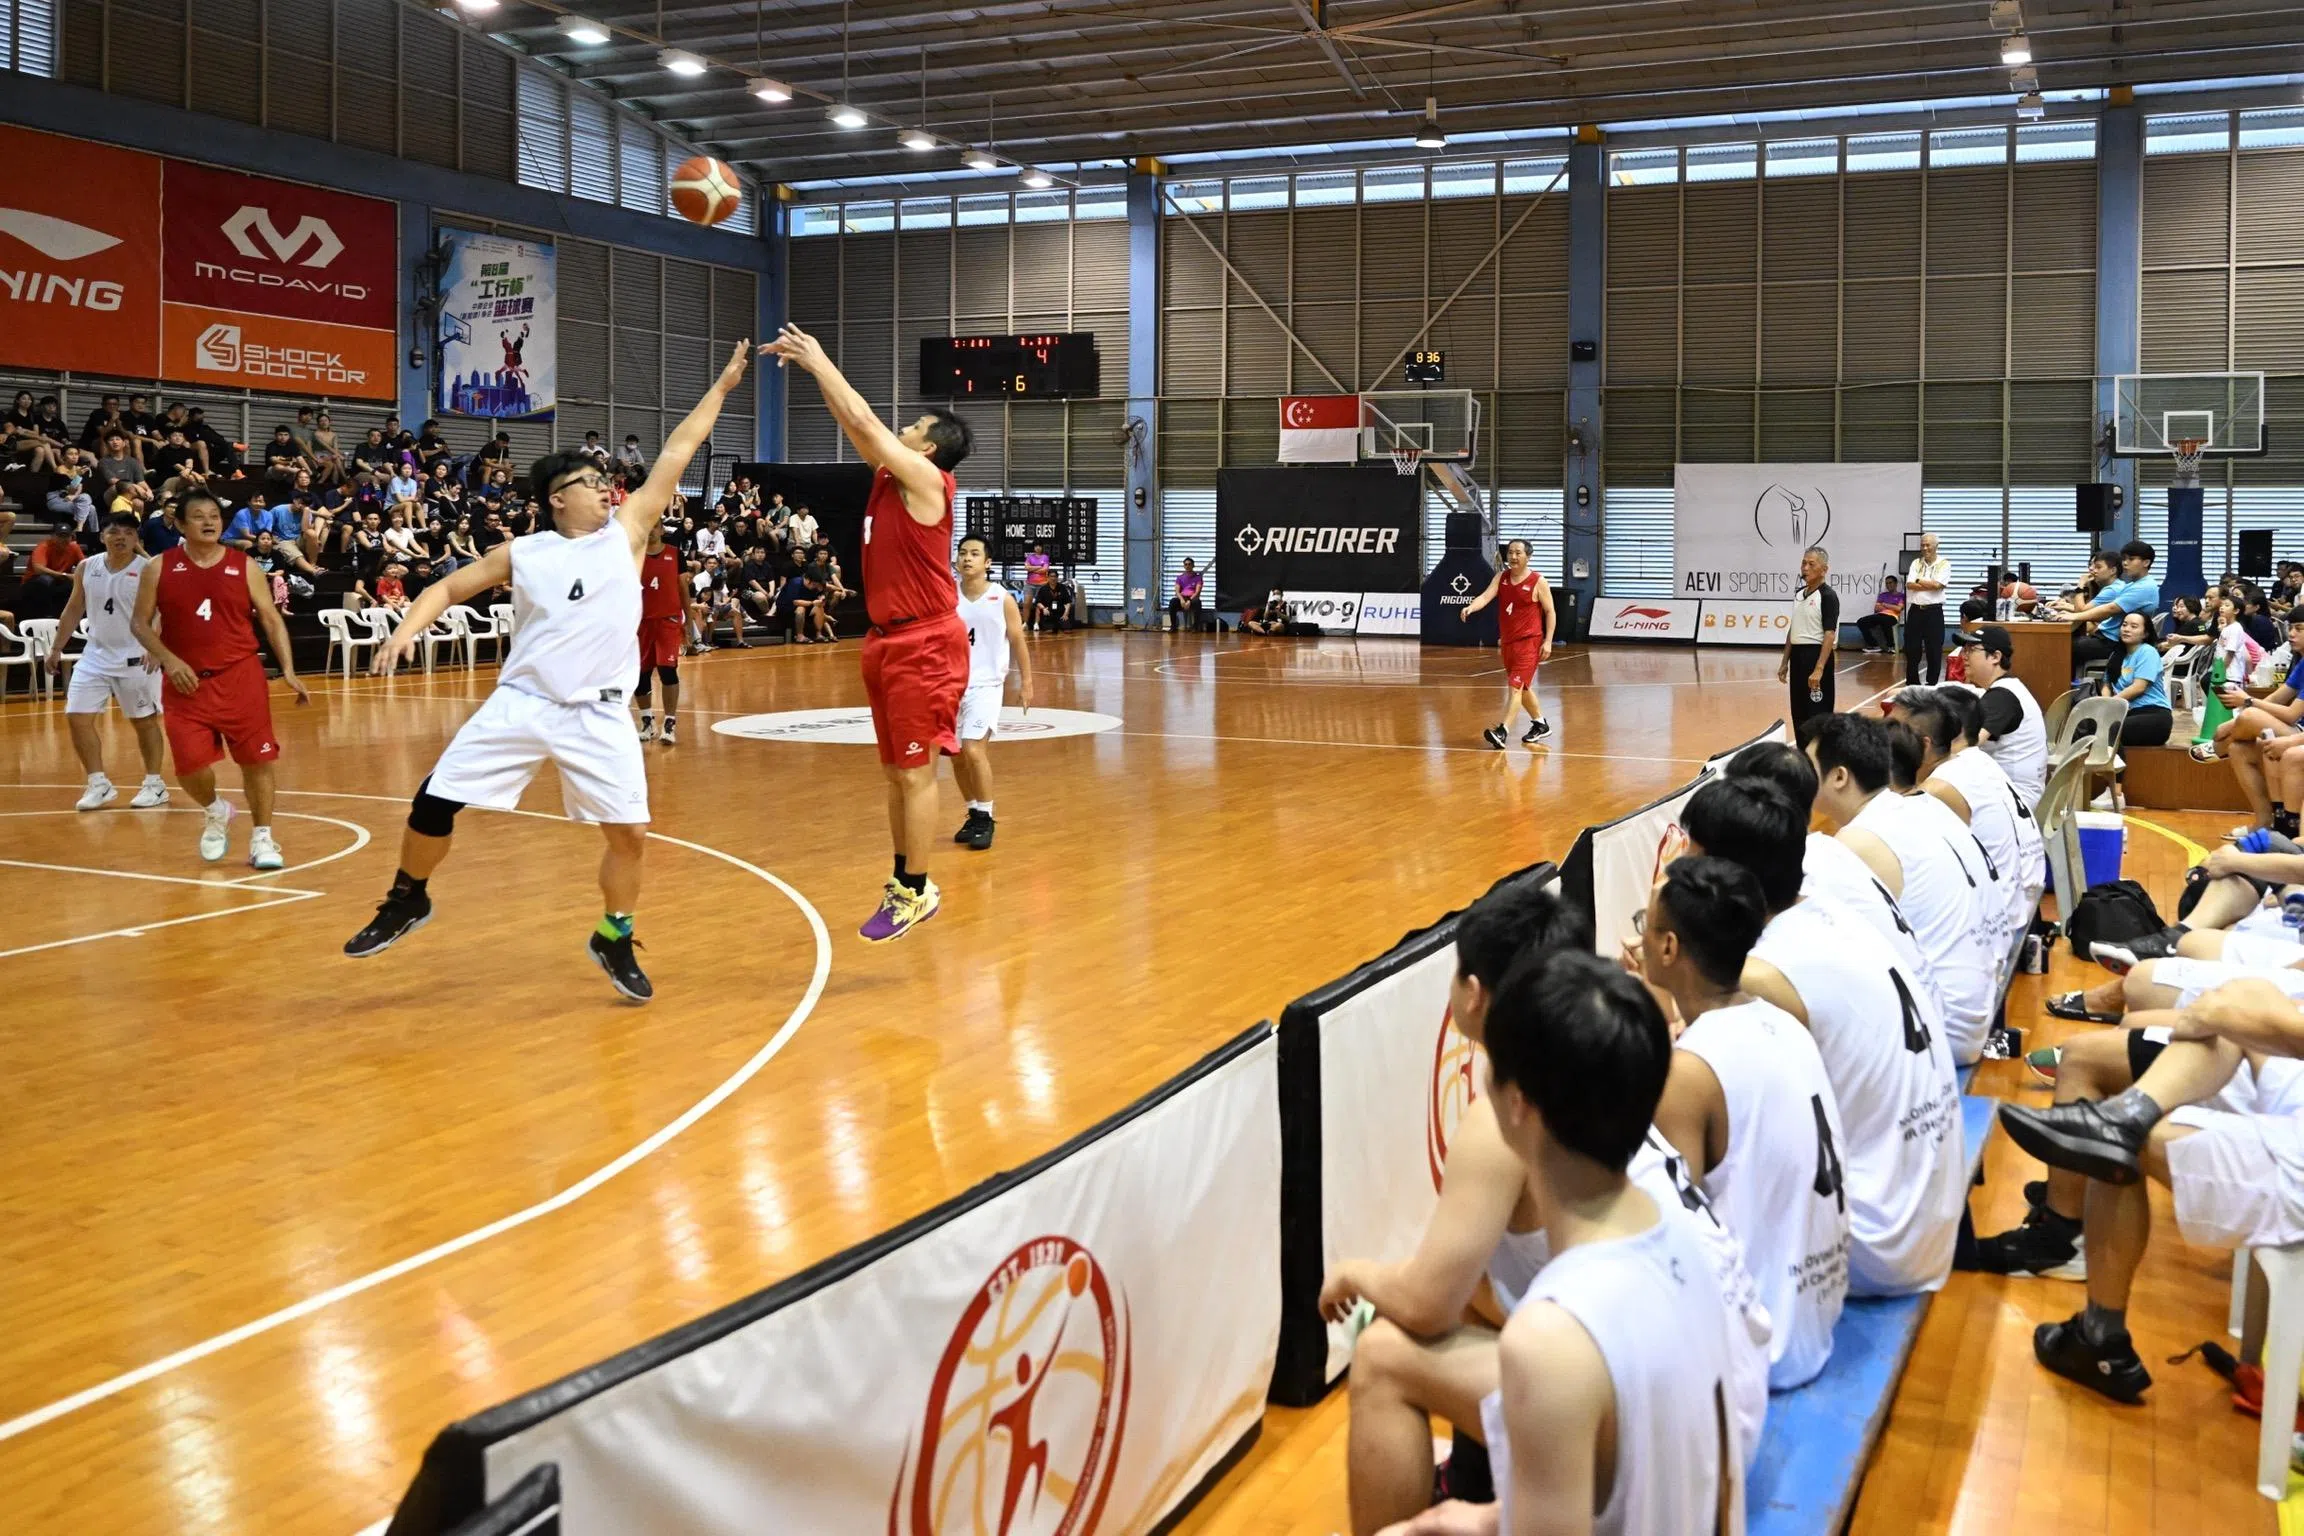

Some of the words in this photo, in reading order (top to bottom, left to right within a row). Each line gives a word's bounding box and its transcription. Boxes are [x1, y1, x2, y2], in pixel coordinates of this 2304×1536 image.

[244, 344, 344, 367] SHOCK
[1036, 349, 1047, 364] 4
[1416, 352, 1424, 363] 8
[1426, 352, 1440, 363] 36
[244, 360, 366, 385] DOCTOR
[1015, 375, 1026, 391] 6
[1005, 524, 1026, 538] HOME
[1036, 524, 1056, 538] GUEST
[1264, 527, 1399, 556] RIGORER
[650, 576, 659, 590] 4
[1685, 571, 1721, 592] AEVI
[1729, 572, 1789, 593] SPORTS
[104, 598, 114, 615] 4
[196, 598, 212, 621] 4
[1364, 606, 1420, 620] RUHE
[1505, 602, 1514, 616] 4
[1613, 620, 1671, 631] LI-NING
[968, 627, 976, 646] 4
[1888, 966, 1935, 1070] 4
[1811, 1093, 1845, 1215] 4
